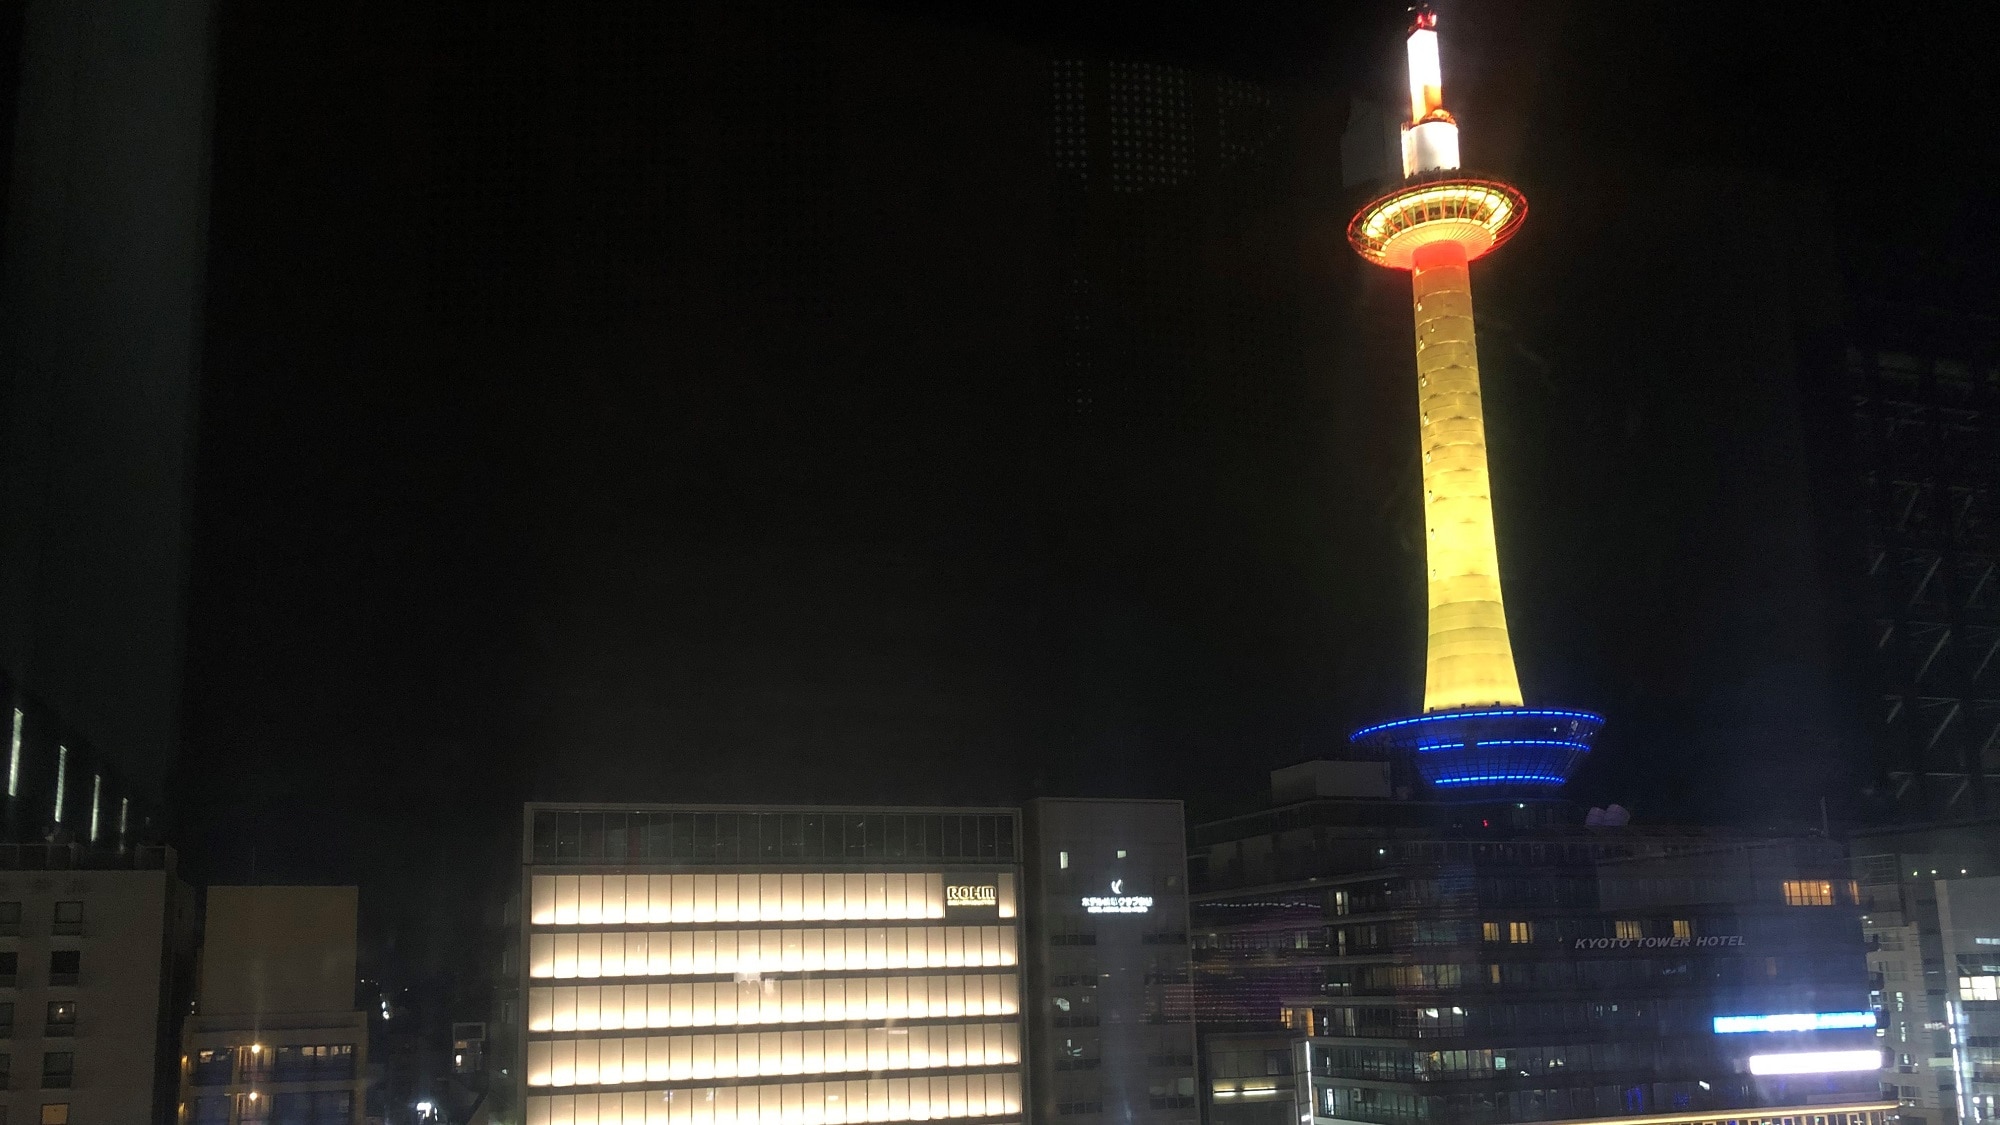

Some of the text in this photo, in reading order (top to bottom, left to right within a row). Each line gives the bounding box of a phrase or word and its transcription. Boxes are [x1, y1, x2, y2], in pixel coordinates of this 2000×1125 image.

[947, 886, 997, 900] ROHM
[1575, 935, 1746, 949] KYOTO TOWER HOTEL
